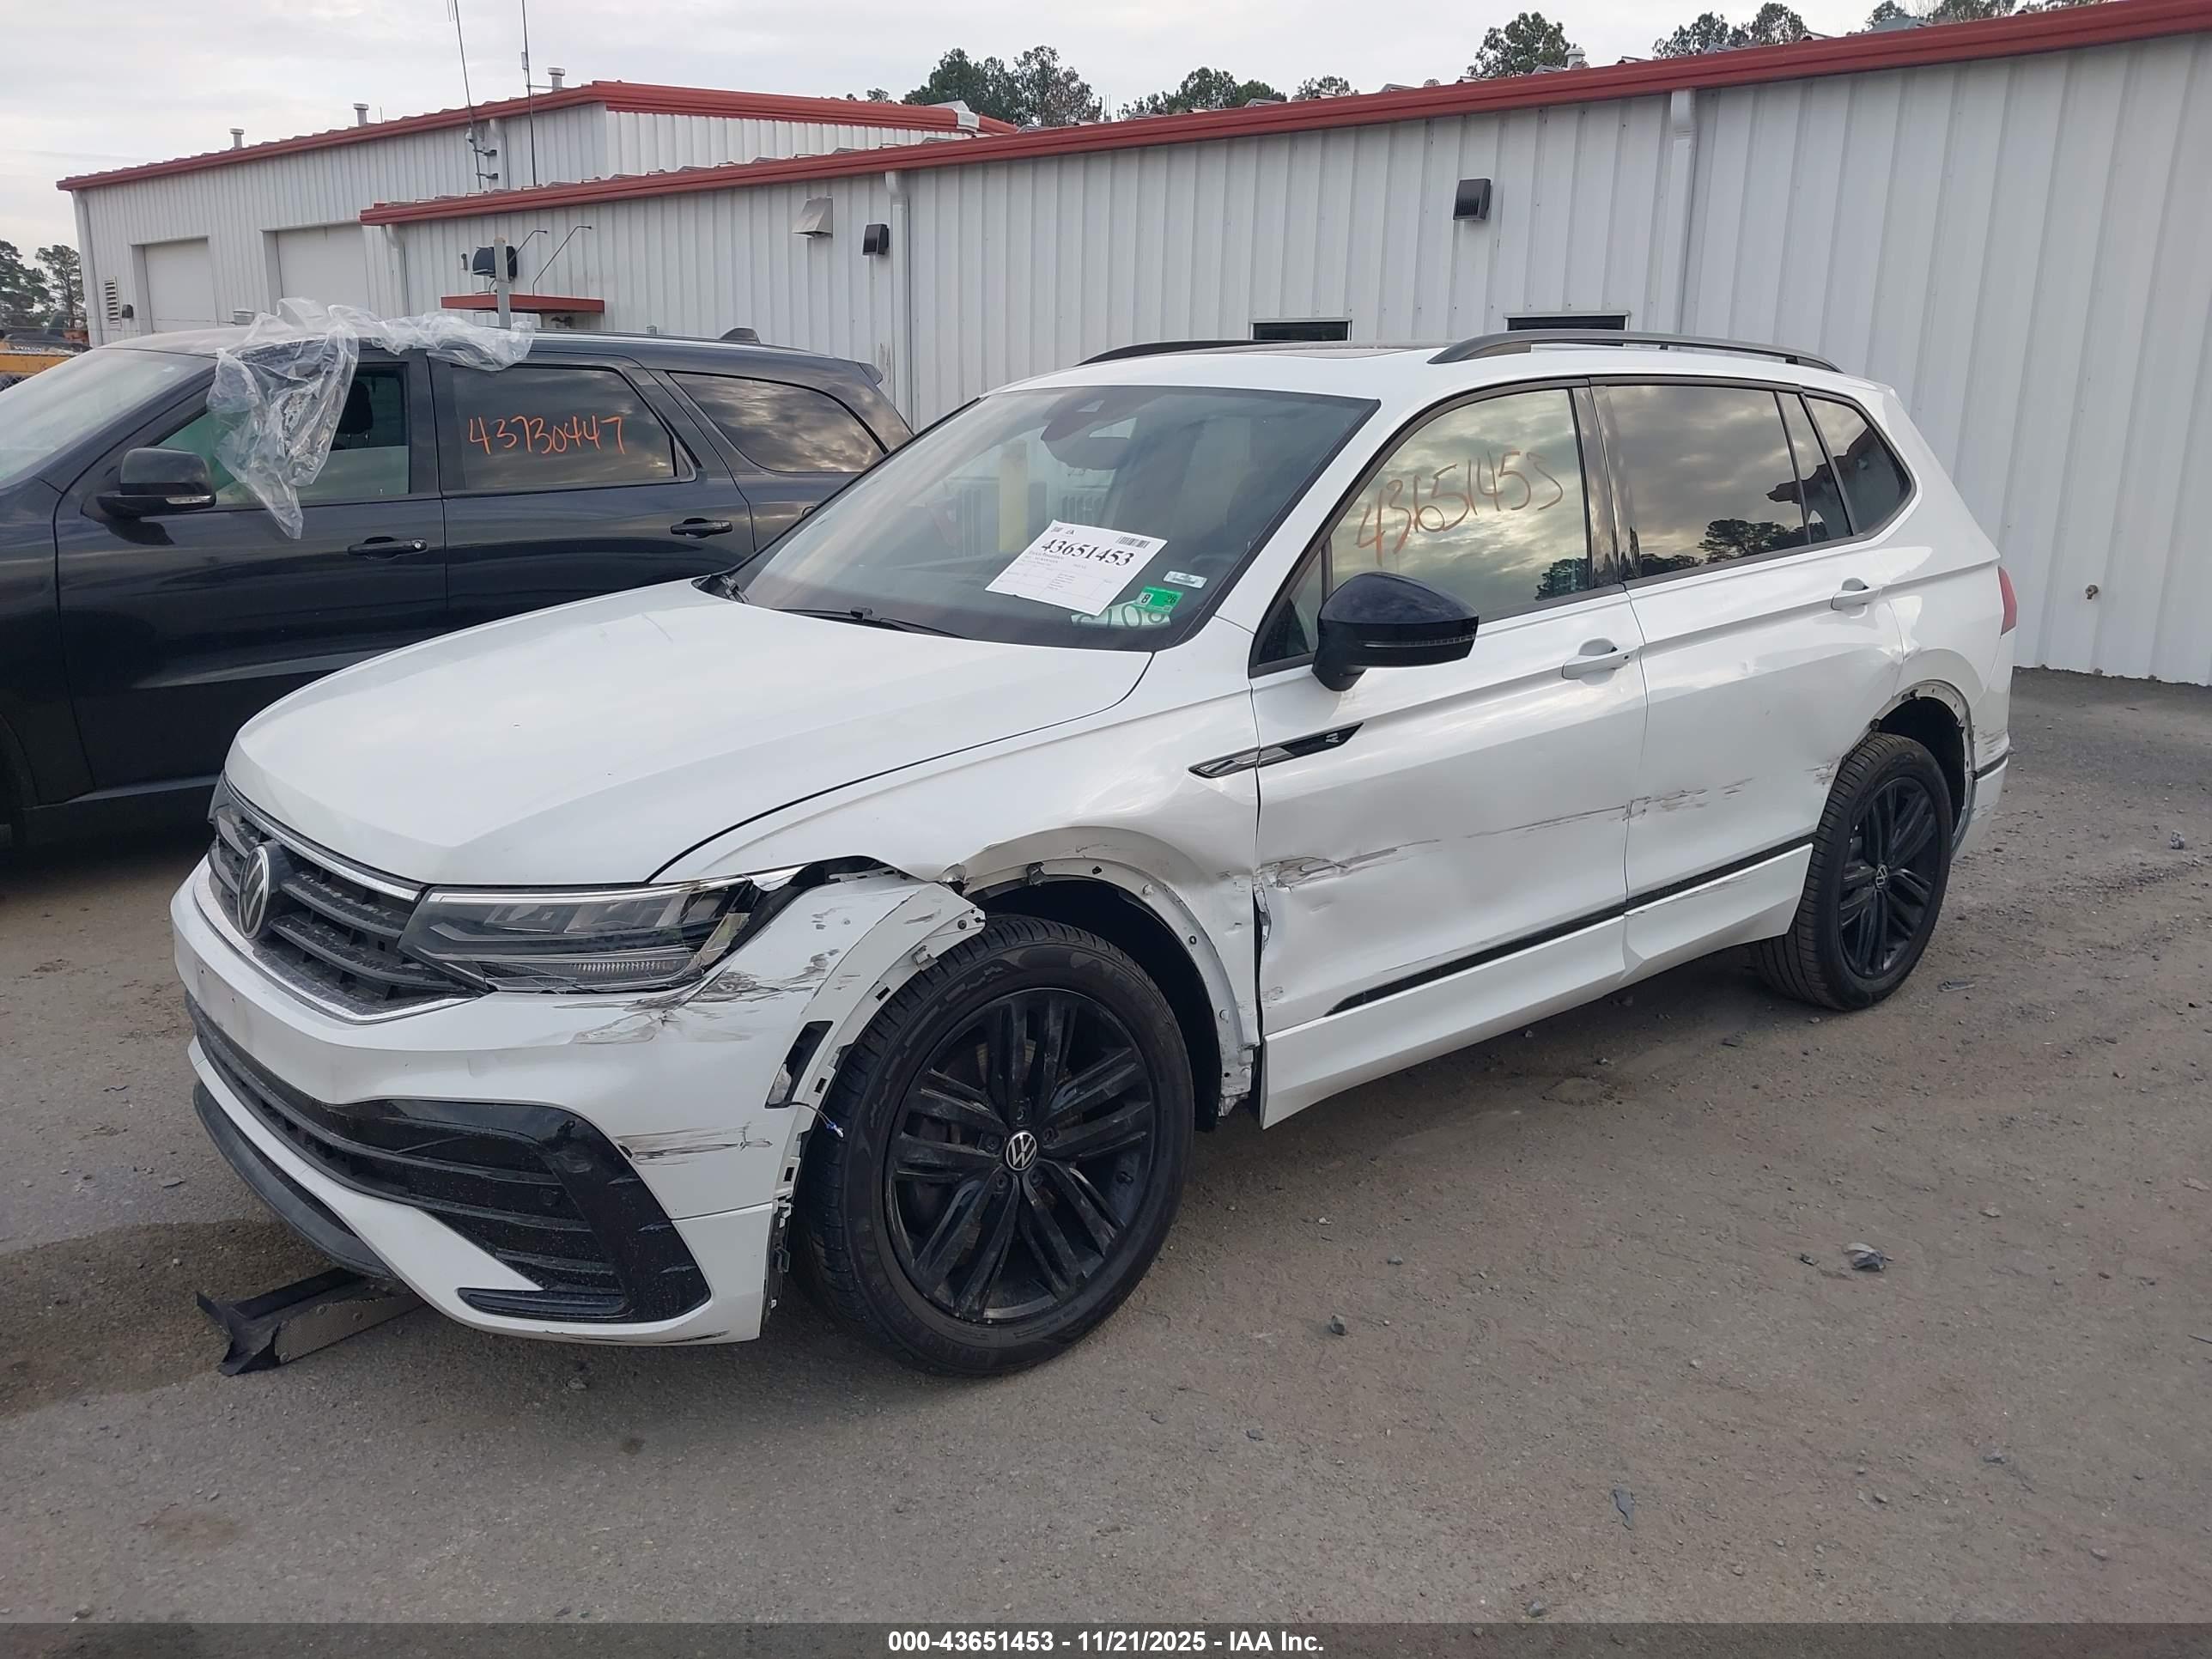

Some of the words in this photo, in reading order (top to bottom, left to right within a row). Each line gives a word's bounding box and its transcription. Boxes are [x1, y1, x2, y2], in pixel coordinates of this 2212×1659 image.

[469, 416, 626, 455] 43730447
[1354, 450, 1564, 567] 43651453
[1042, 538, 1135, 566] 43651453
[1006, 1132, 1037, 1171] VW
